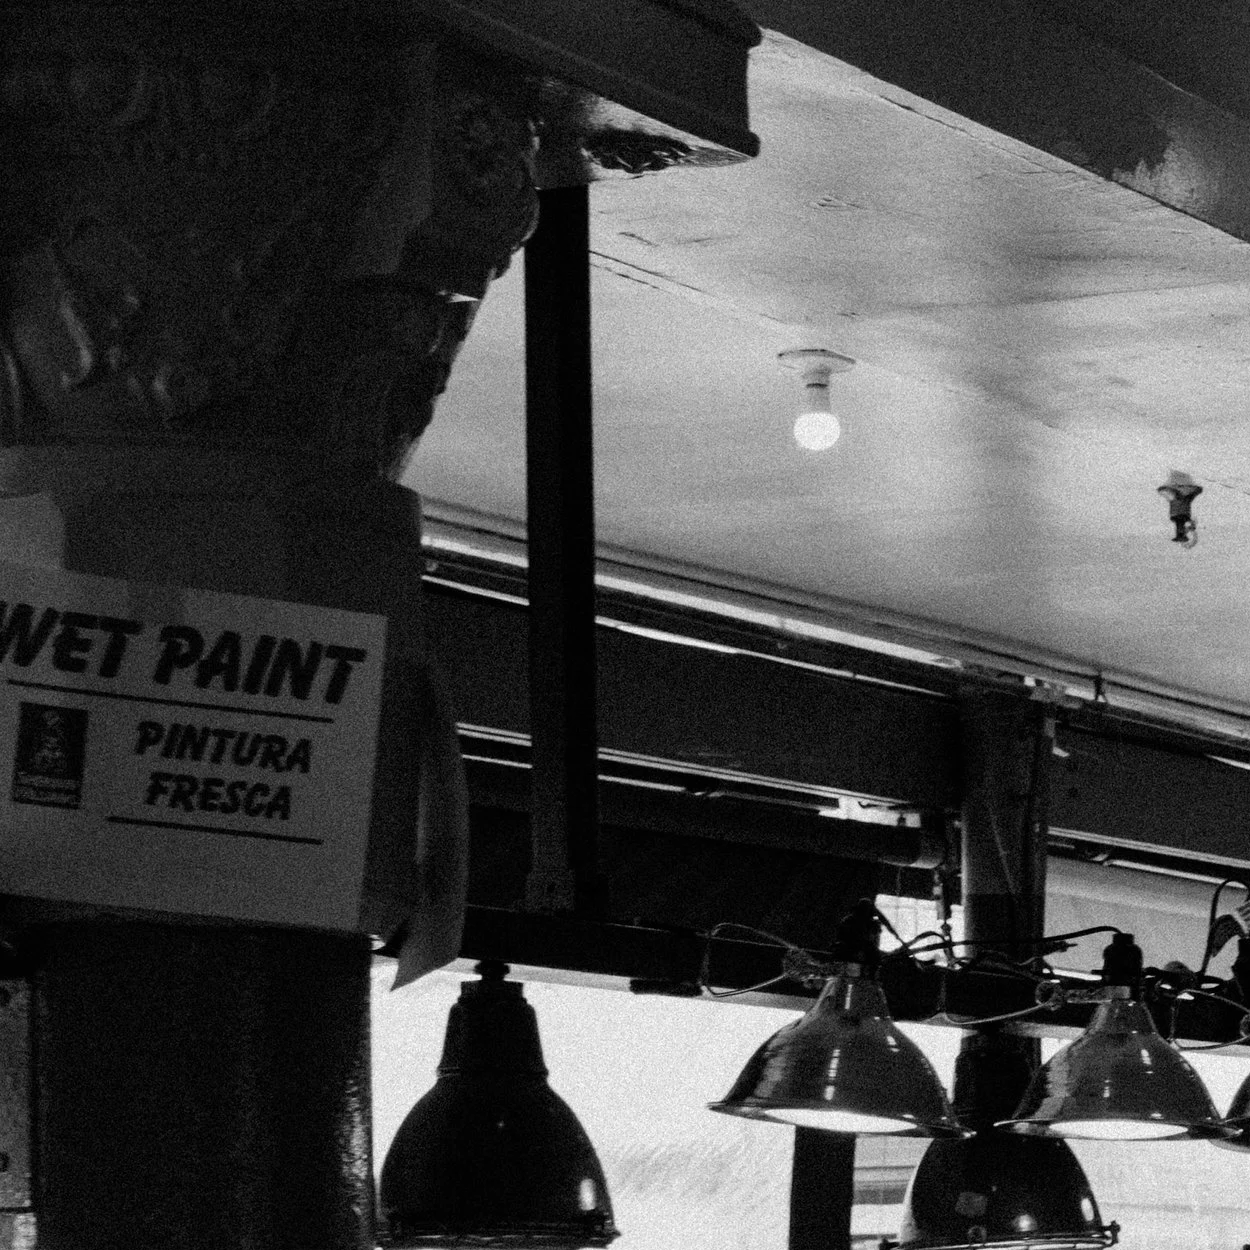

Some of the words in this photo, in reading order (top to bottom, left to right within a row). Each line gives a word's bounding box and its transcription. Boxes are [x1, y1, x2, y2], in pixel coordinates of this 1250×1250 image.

[0, 602, 143, 678] WET
[153, 625, 367, 704] PAINT
[134, 720, 312, 774] PINTURA
[147, 771, 292, 821] FRESCA
